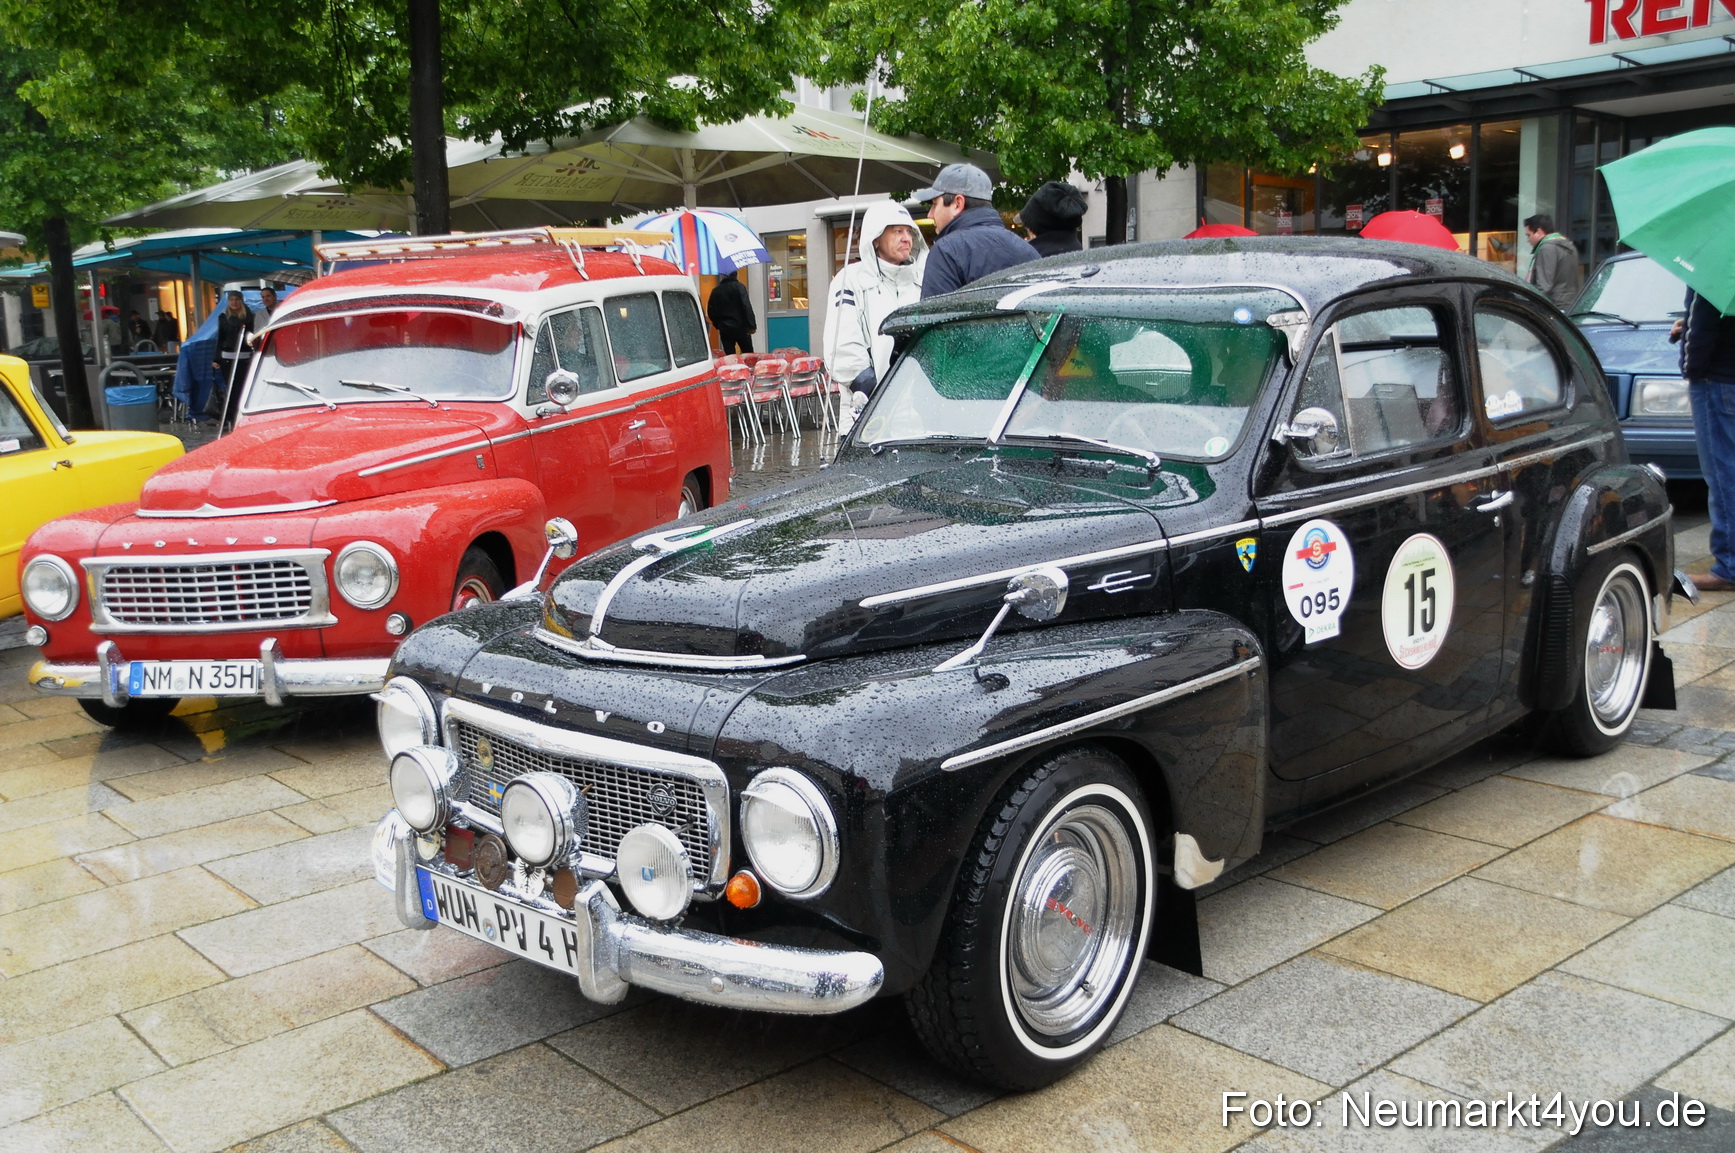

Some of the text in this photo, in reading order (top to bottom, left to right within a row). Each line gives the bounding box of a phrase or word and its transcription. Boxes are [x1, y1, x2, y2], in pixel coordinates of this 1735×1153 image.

[1347, 211, 1362, 219] 20%
[122, 536, 278, 550] VOLVO
[1300, 587, 1341, 619] 095
[1404, 567, 1436, 638] 15
[143, 665, 255, 690] NM N 35H
[482, 682, 666, 734] VOLVO
[649, 794, 676, 806] VOLVO
[433, 879, 481, 933] WUN
[494, 903, 528, 952] PV
